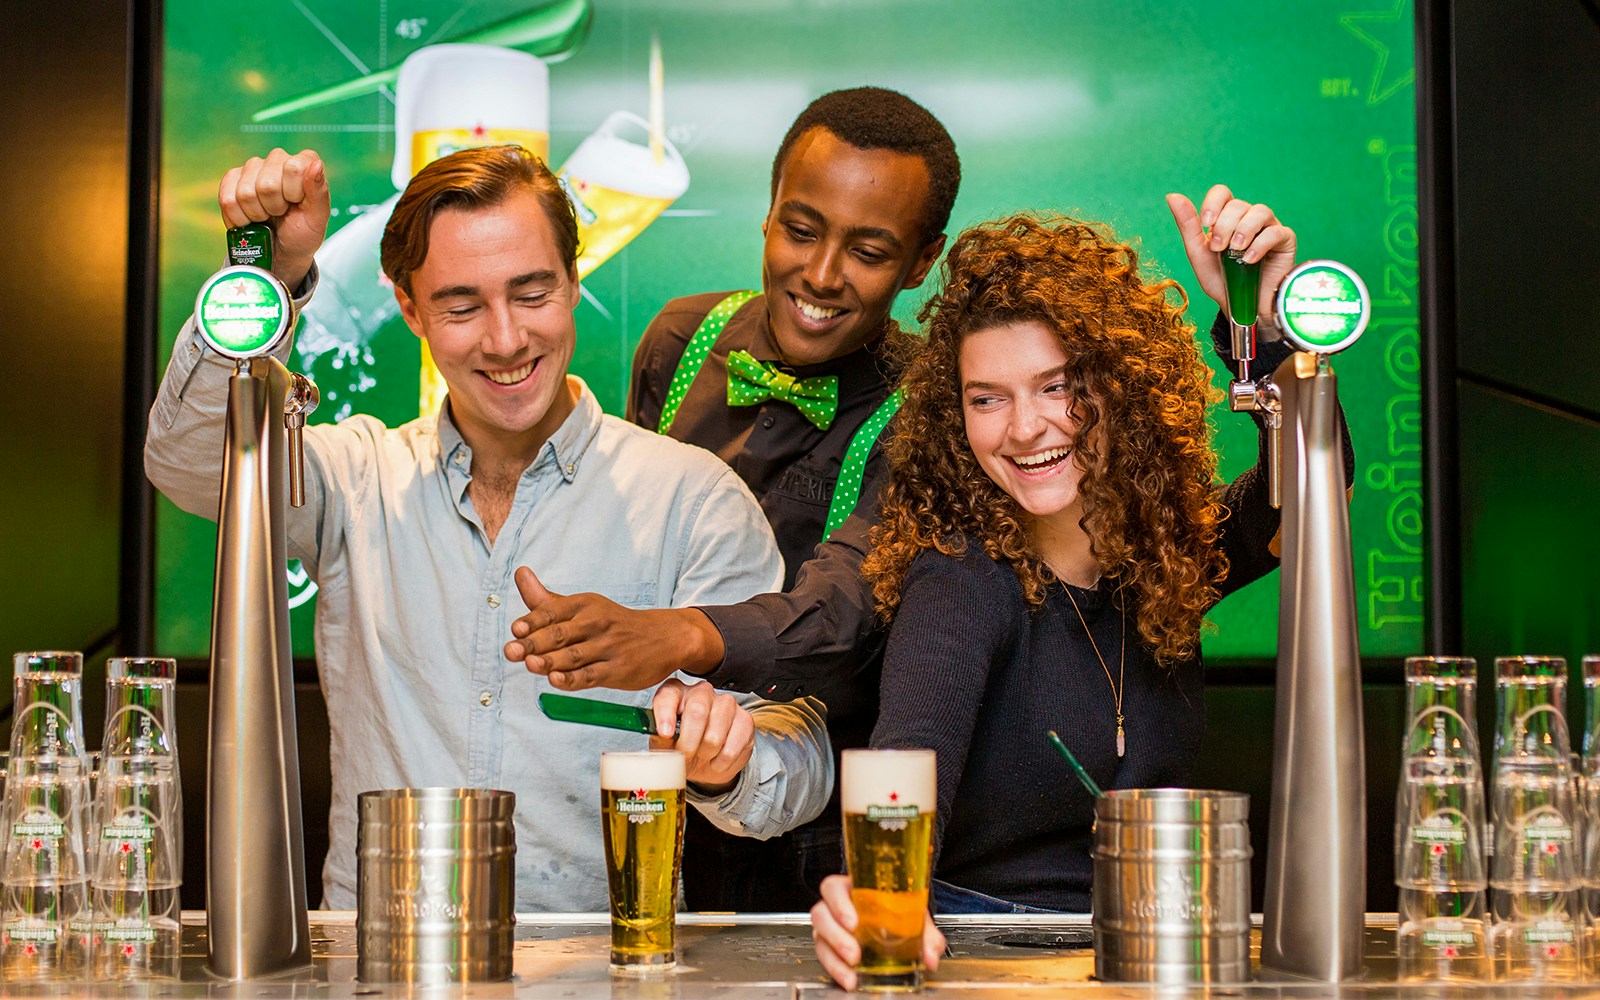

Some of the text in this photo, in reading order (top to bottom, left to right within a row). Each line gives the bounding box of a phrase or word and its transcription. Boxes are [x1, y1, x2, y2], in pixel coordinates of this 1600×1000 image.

[232, 248, 260, 257] Heineken
[776, 469, 834, 503] EXPERIE
[618, 801, 664, 813] Heineken
[107, 928, 154, 940] Heineken
